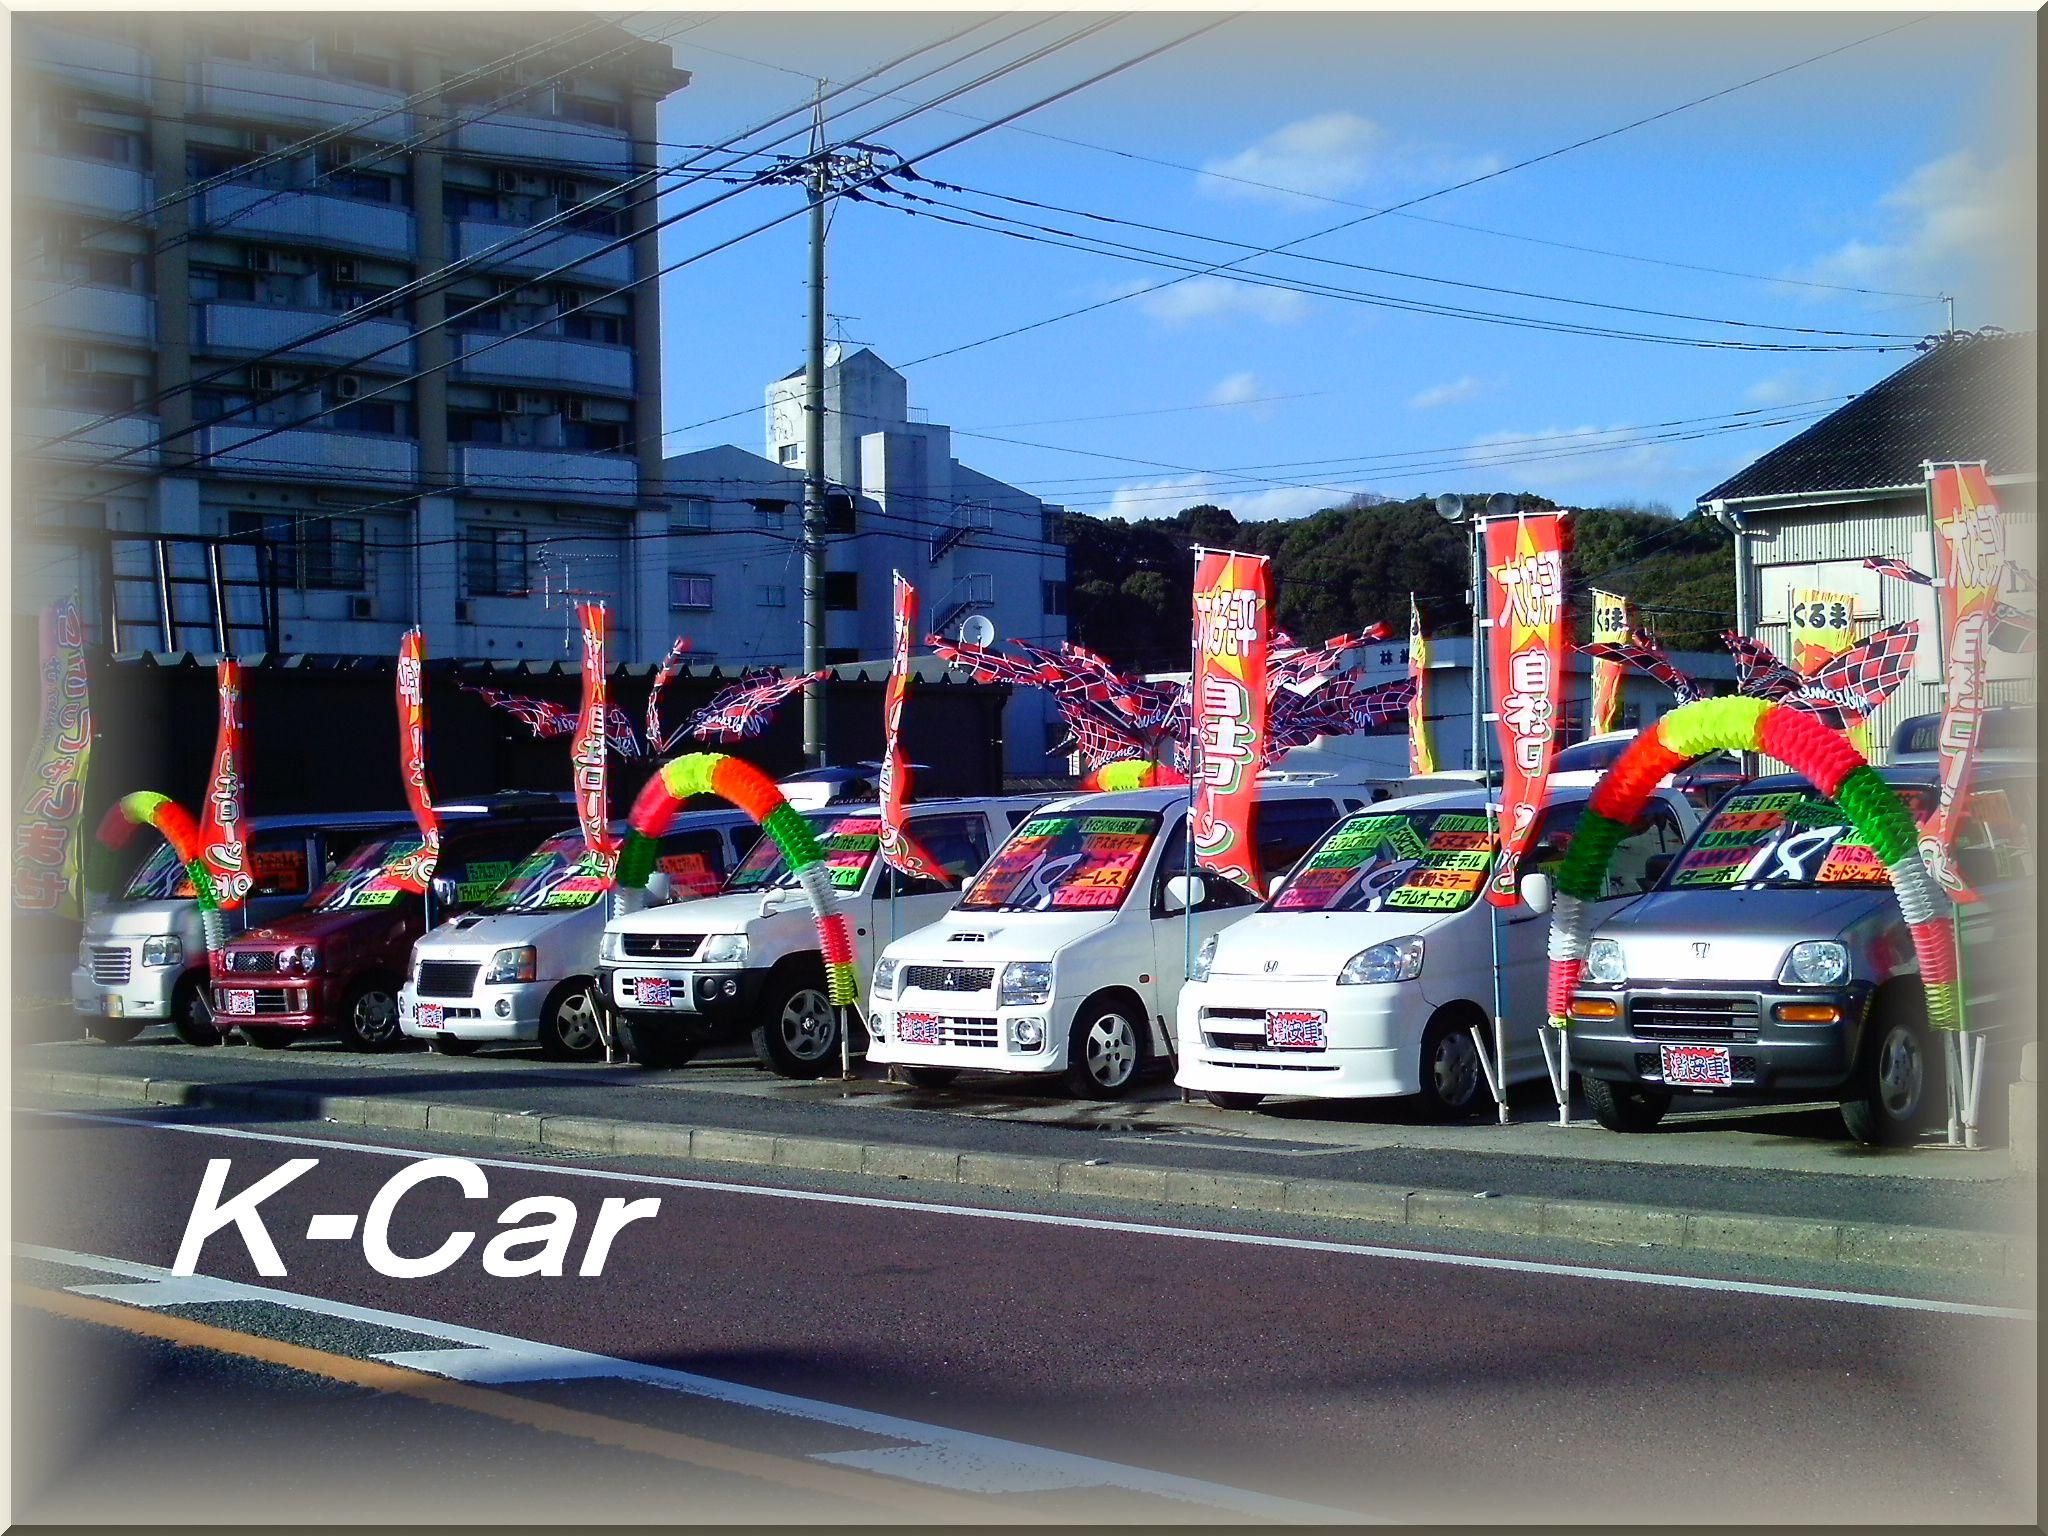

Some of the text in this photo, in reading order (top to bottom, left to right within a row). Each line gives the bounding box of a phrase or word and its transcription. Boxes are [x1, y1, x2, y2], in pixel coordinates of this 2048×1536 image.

[1793, 602, 1848, 630] くるま
[1065, 870, 1122, 885] キーレス
[1676, 866, 1739, 882] ターボ
[1390, 890, 1457, 904] コラムオートマ
[1274, 1018, 1322, 1043] 激安車
[1671, 1055, 1725, 1080] 激安車
